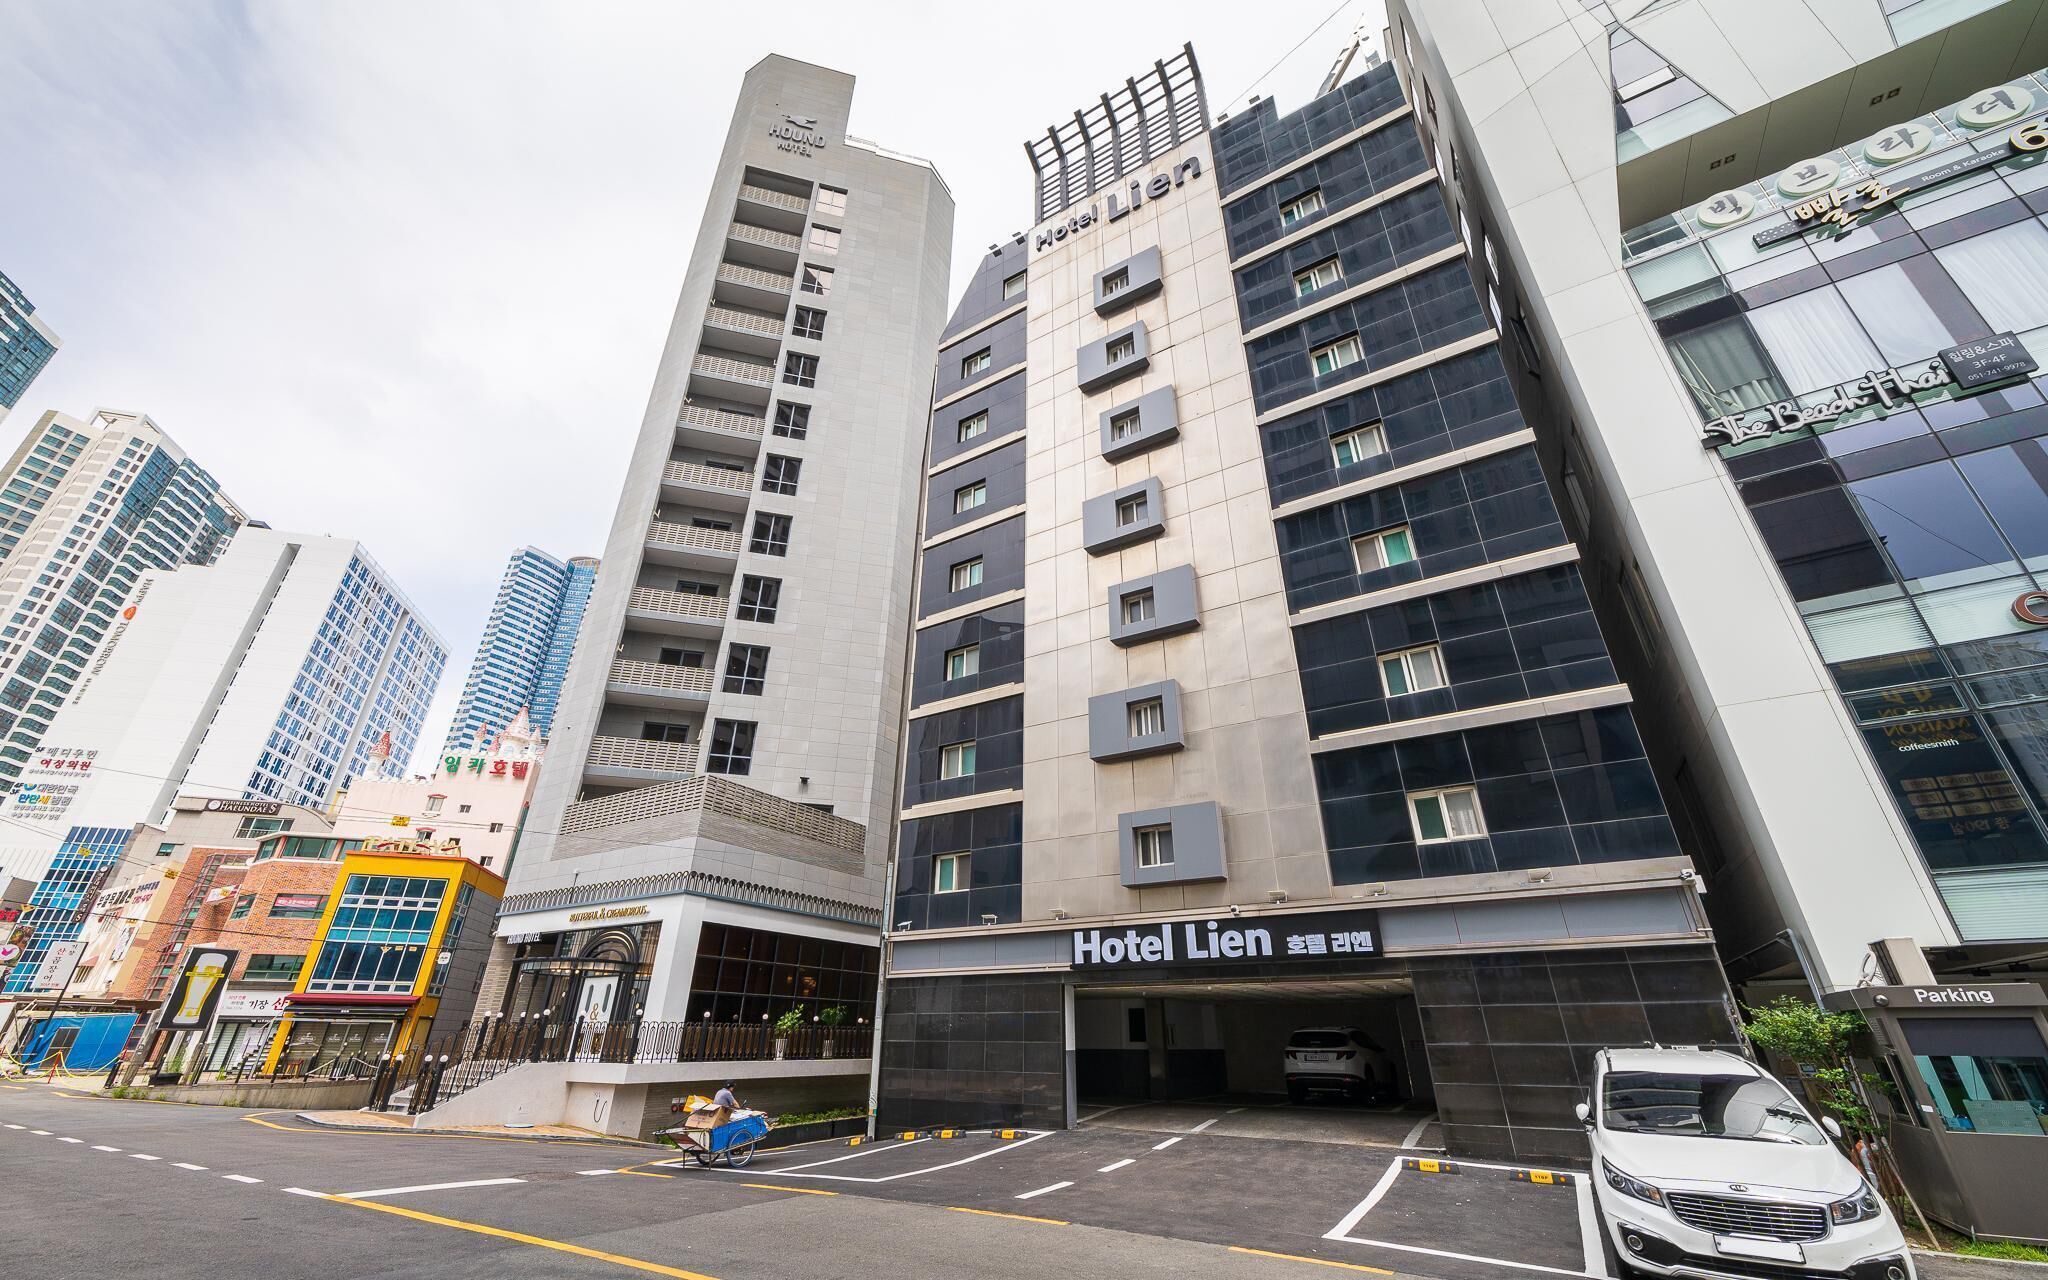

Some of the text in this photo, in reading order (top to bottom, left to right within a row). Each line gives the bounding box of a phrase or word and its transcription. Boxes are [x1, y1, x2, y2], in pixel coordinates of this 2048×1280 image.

[769, 123, 826, 148] HOUND
[777, 143, 813, 157] HOTEL
[1921, 168, 1951, 182] Room
[1962, 149, 2005, 167] Karaoke
[1035, 156, 1201, 251] Hotel Lien
[1948, 337, 2015, 362] 힐링&스파
[1968, 361, 2026, 381] 051-741-9978
[1703, 361, 1951, 445] The Beach Thai
[91, 621, 130, 676] TOMORROW
[1898, 738, 1959, 752] coffeesmith
[40, 758, 92, 771] 여성의원
[489, 760, 529, 779] 호텔
[37, 783, 79, 795] 대한민국
[18, 793, 51, 805] 만만세
[220, 803, 278, 814] HAEUNDAE S
[1073, 921, 1374, 964] Hotel Lien 호텔 리엔
[249, 999, 270, 1010] 기장
[1914, 988, 1994, 1004] Parking
